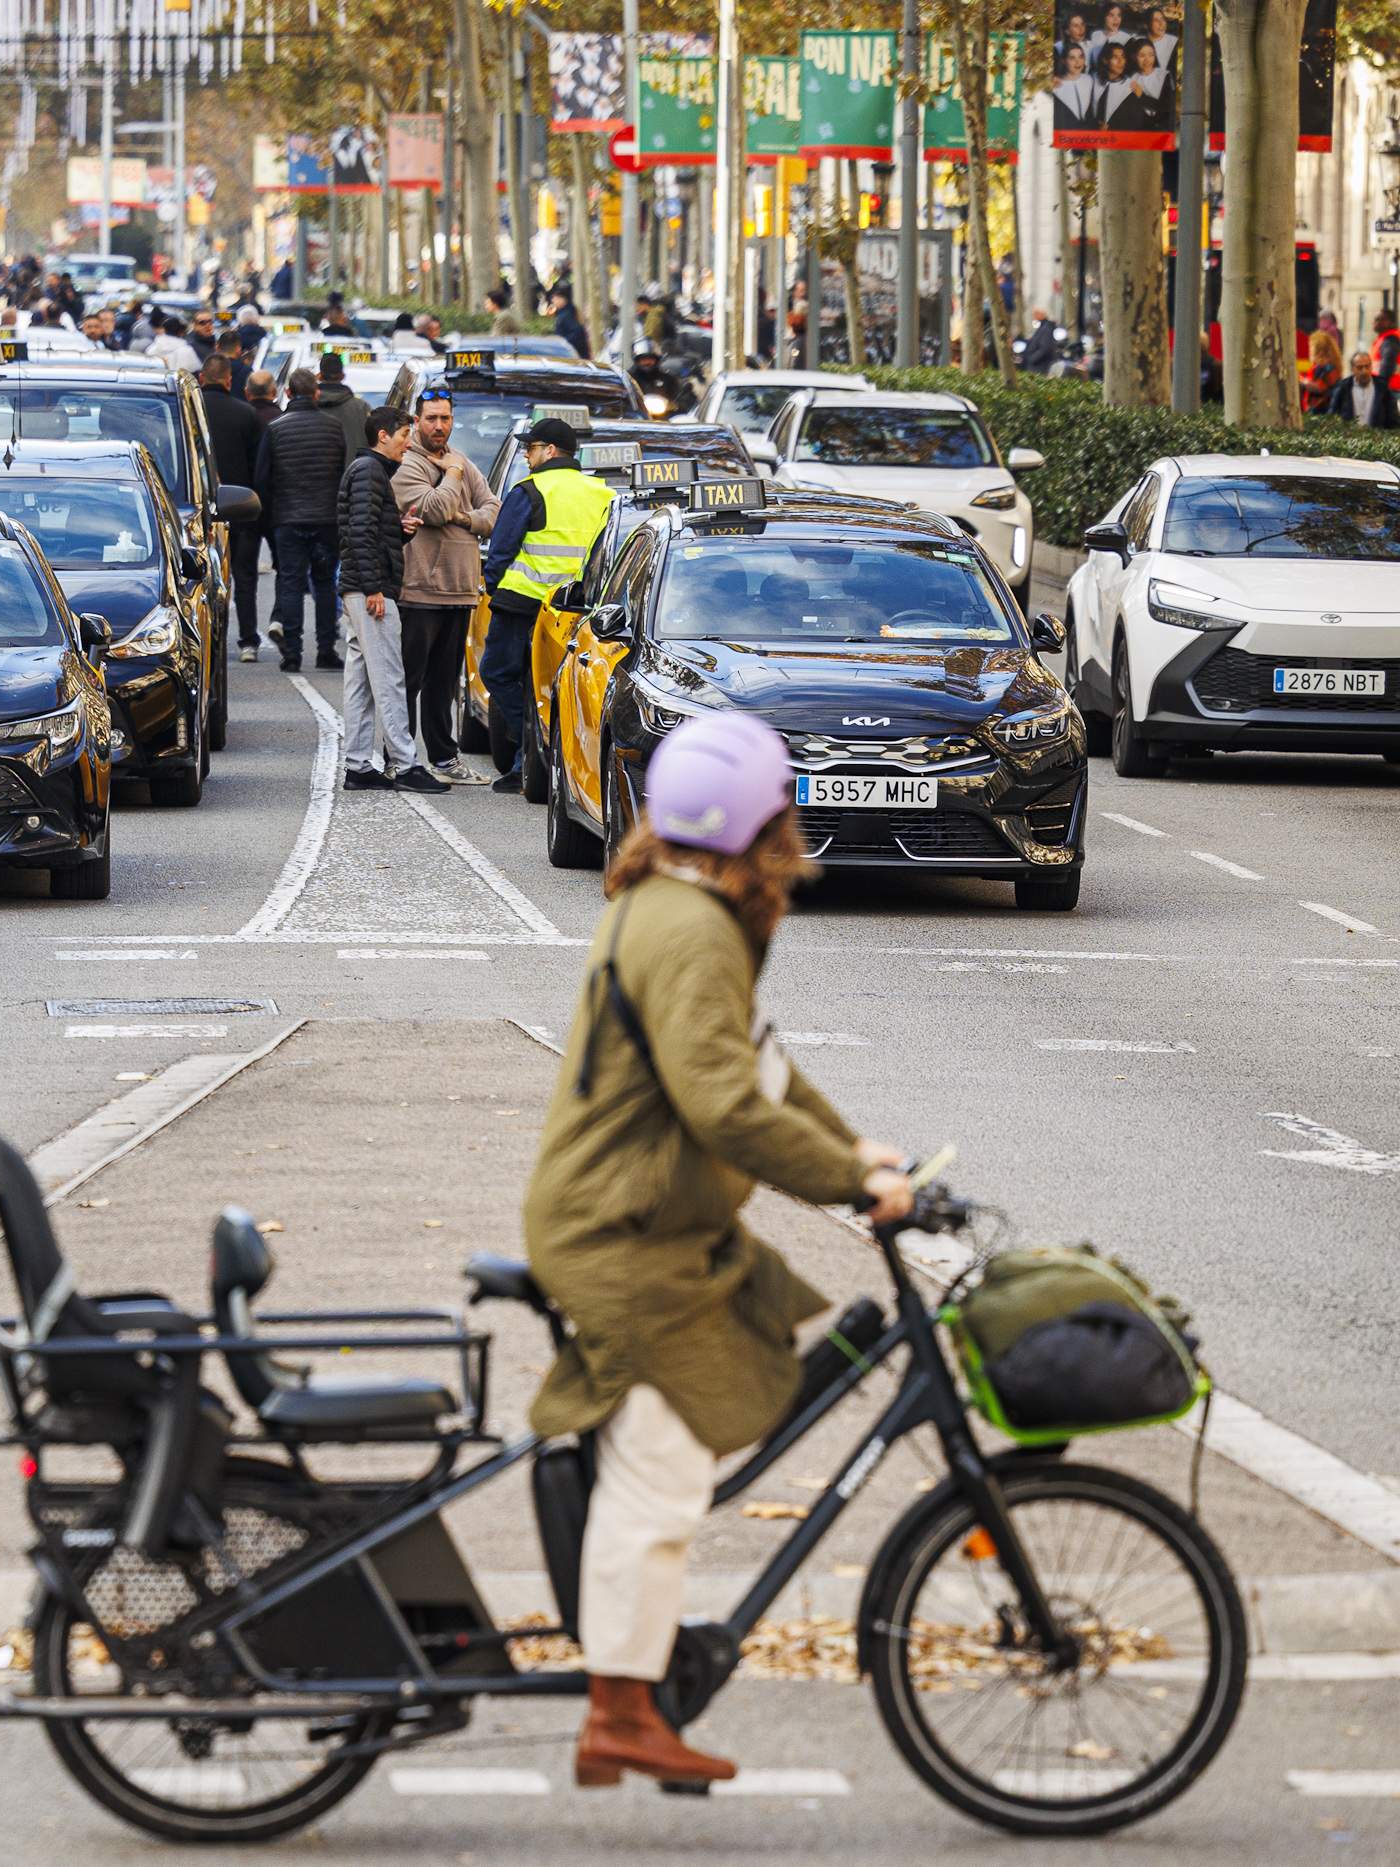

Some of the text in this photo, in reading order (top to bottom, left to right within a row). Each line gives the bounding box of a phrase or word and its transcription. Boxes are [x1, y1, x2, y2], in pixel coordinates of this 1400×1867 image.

[804, 34, 893, 88] BON NA
[1, 345, 15, 358] XI
[352, 353, 371, 363] TAXI
[455, 353, 481, 367] TAXI
[593, 447, 621, 463] TAXI
[643, 463, 679, 482] TAXI
[704, 484, 744, 506] TAXI
[1288, 673, 1379, 691] 2876 NBT
[815, 780, 876, 802] 5957
[886, 781, 930, 803] MHC
